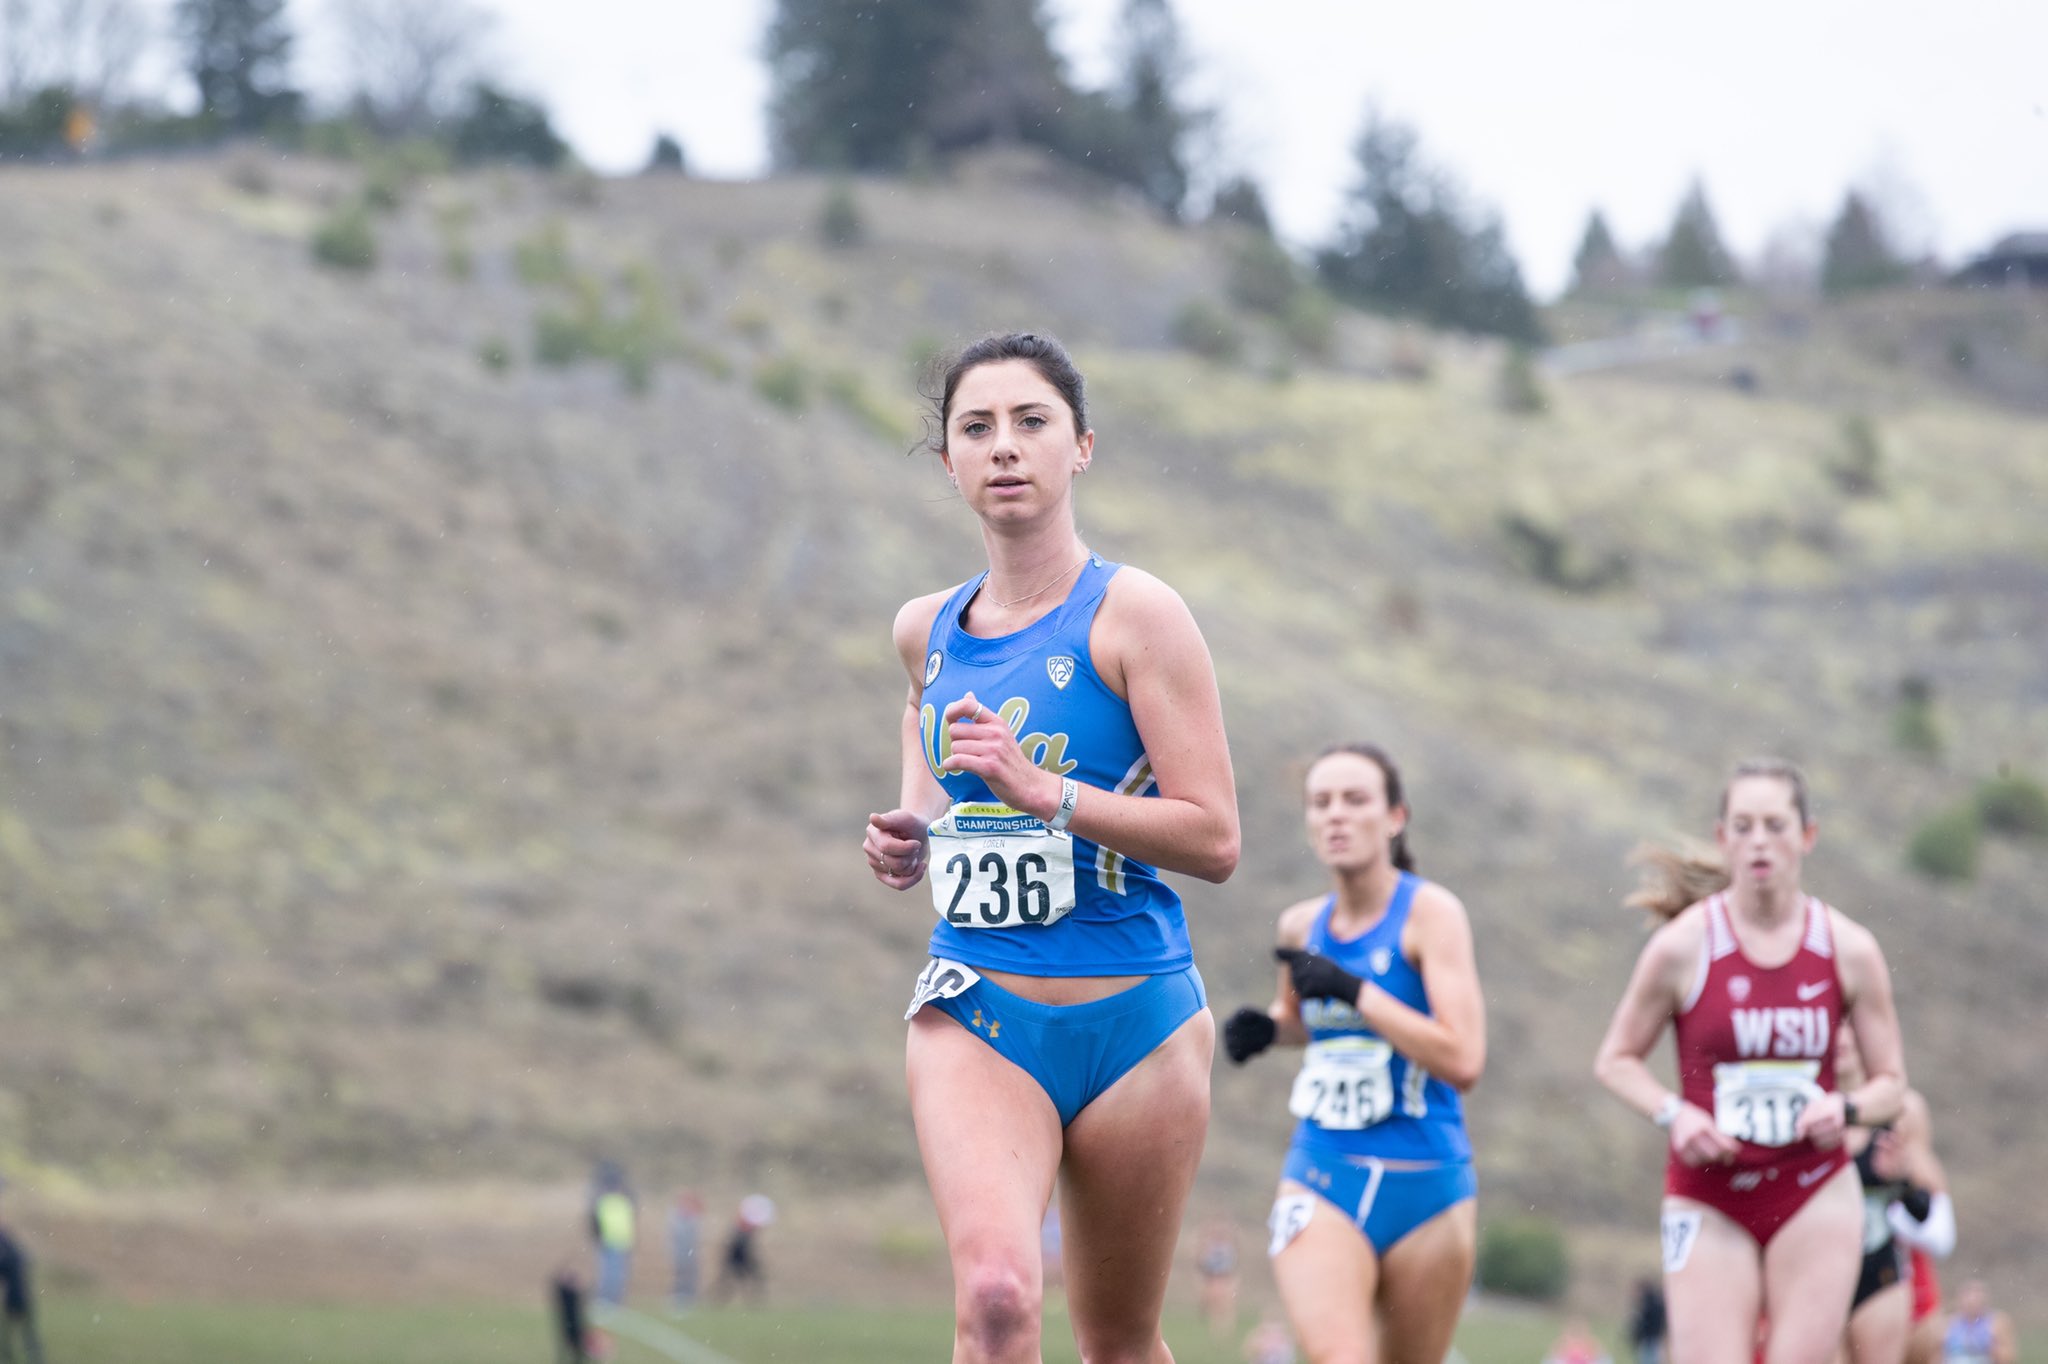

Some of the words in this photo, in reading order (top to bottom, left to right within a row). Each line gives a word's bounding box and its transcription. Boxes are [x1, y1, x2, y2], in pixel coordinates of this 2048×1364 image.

[1049, 657, 1073, 675] PAC
[1054, 670, 1067, 682] 12
[920, 696, 1078, 779] Ula
[945, 852, 1051, 925] 236
[1731, 1006, 1829, 1057] WSU
[1309, 1078, 1376, 1124] 246
